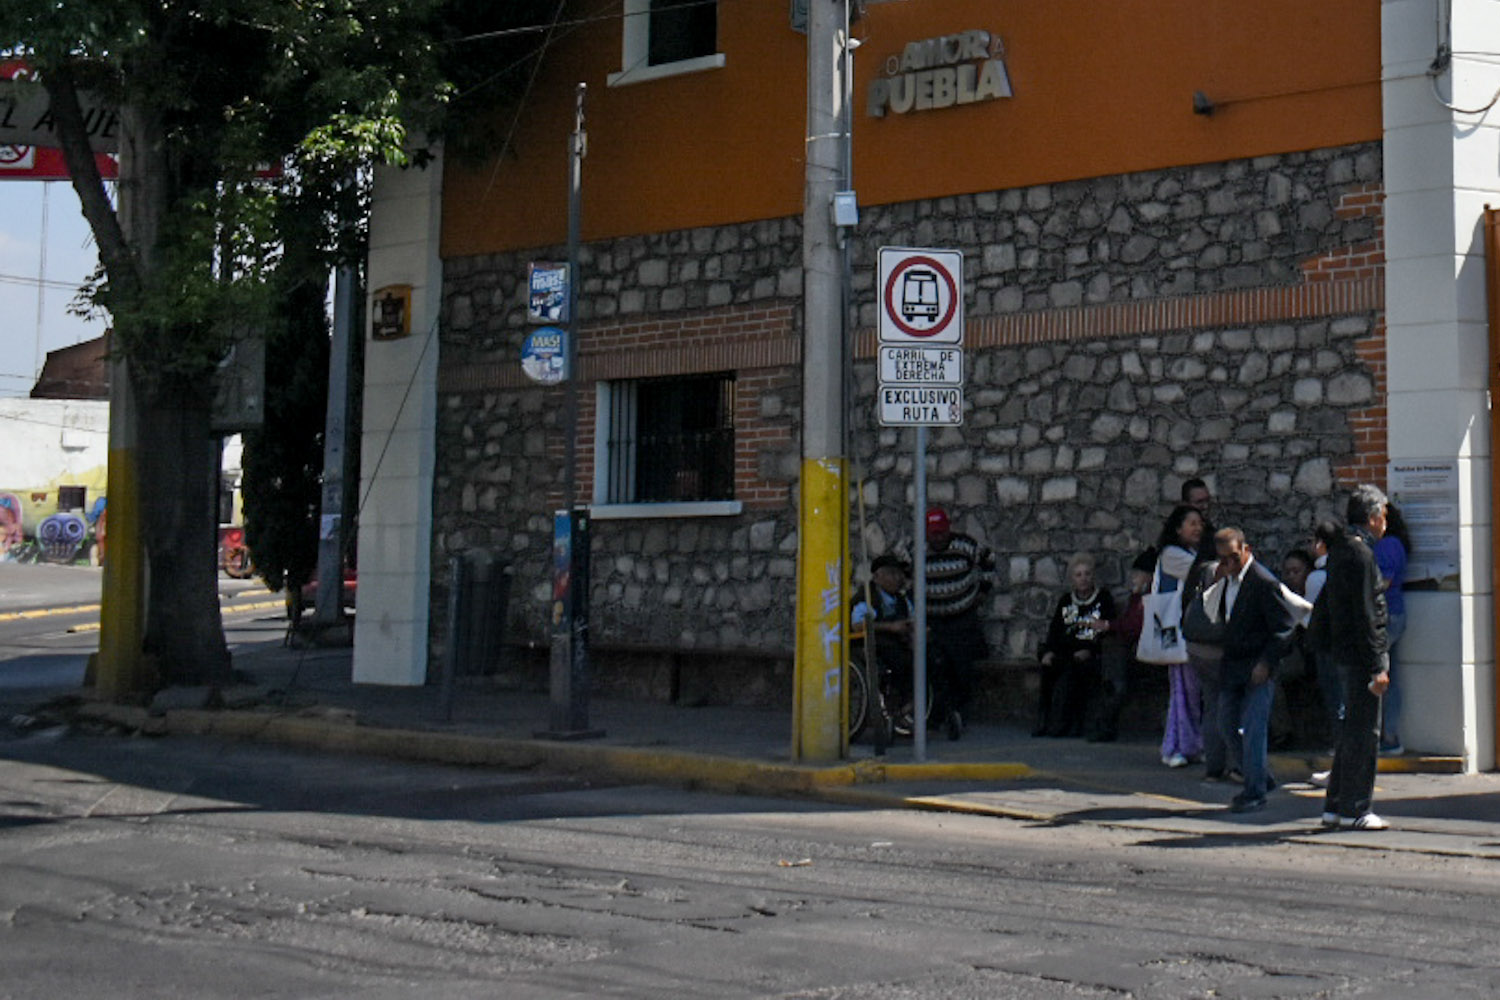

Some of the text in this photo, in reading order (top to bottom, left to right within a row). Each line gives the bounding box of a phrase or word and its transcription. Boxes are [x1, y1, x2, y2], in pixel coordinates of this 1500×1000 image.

[903, 29, 992, 72] AMOR
[867, 60, 1014, 118] PUEBLA
[888, 349, 954, 362] CARRIL DE
[895, 360, 945, 371] EXTREMA
[895, 370, 945, 380] DERECHA
[885, 390, 957, 404] EXCLUSIVO
[903, 407, 939, 420] RUTA
